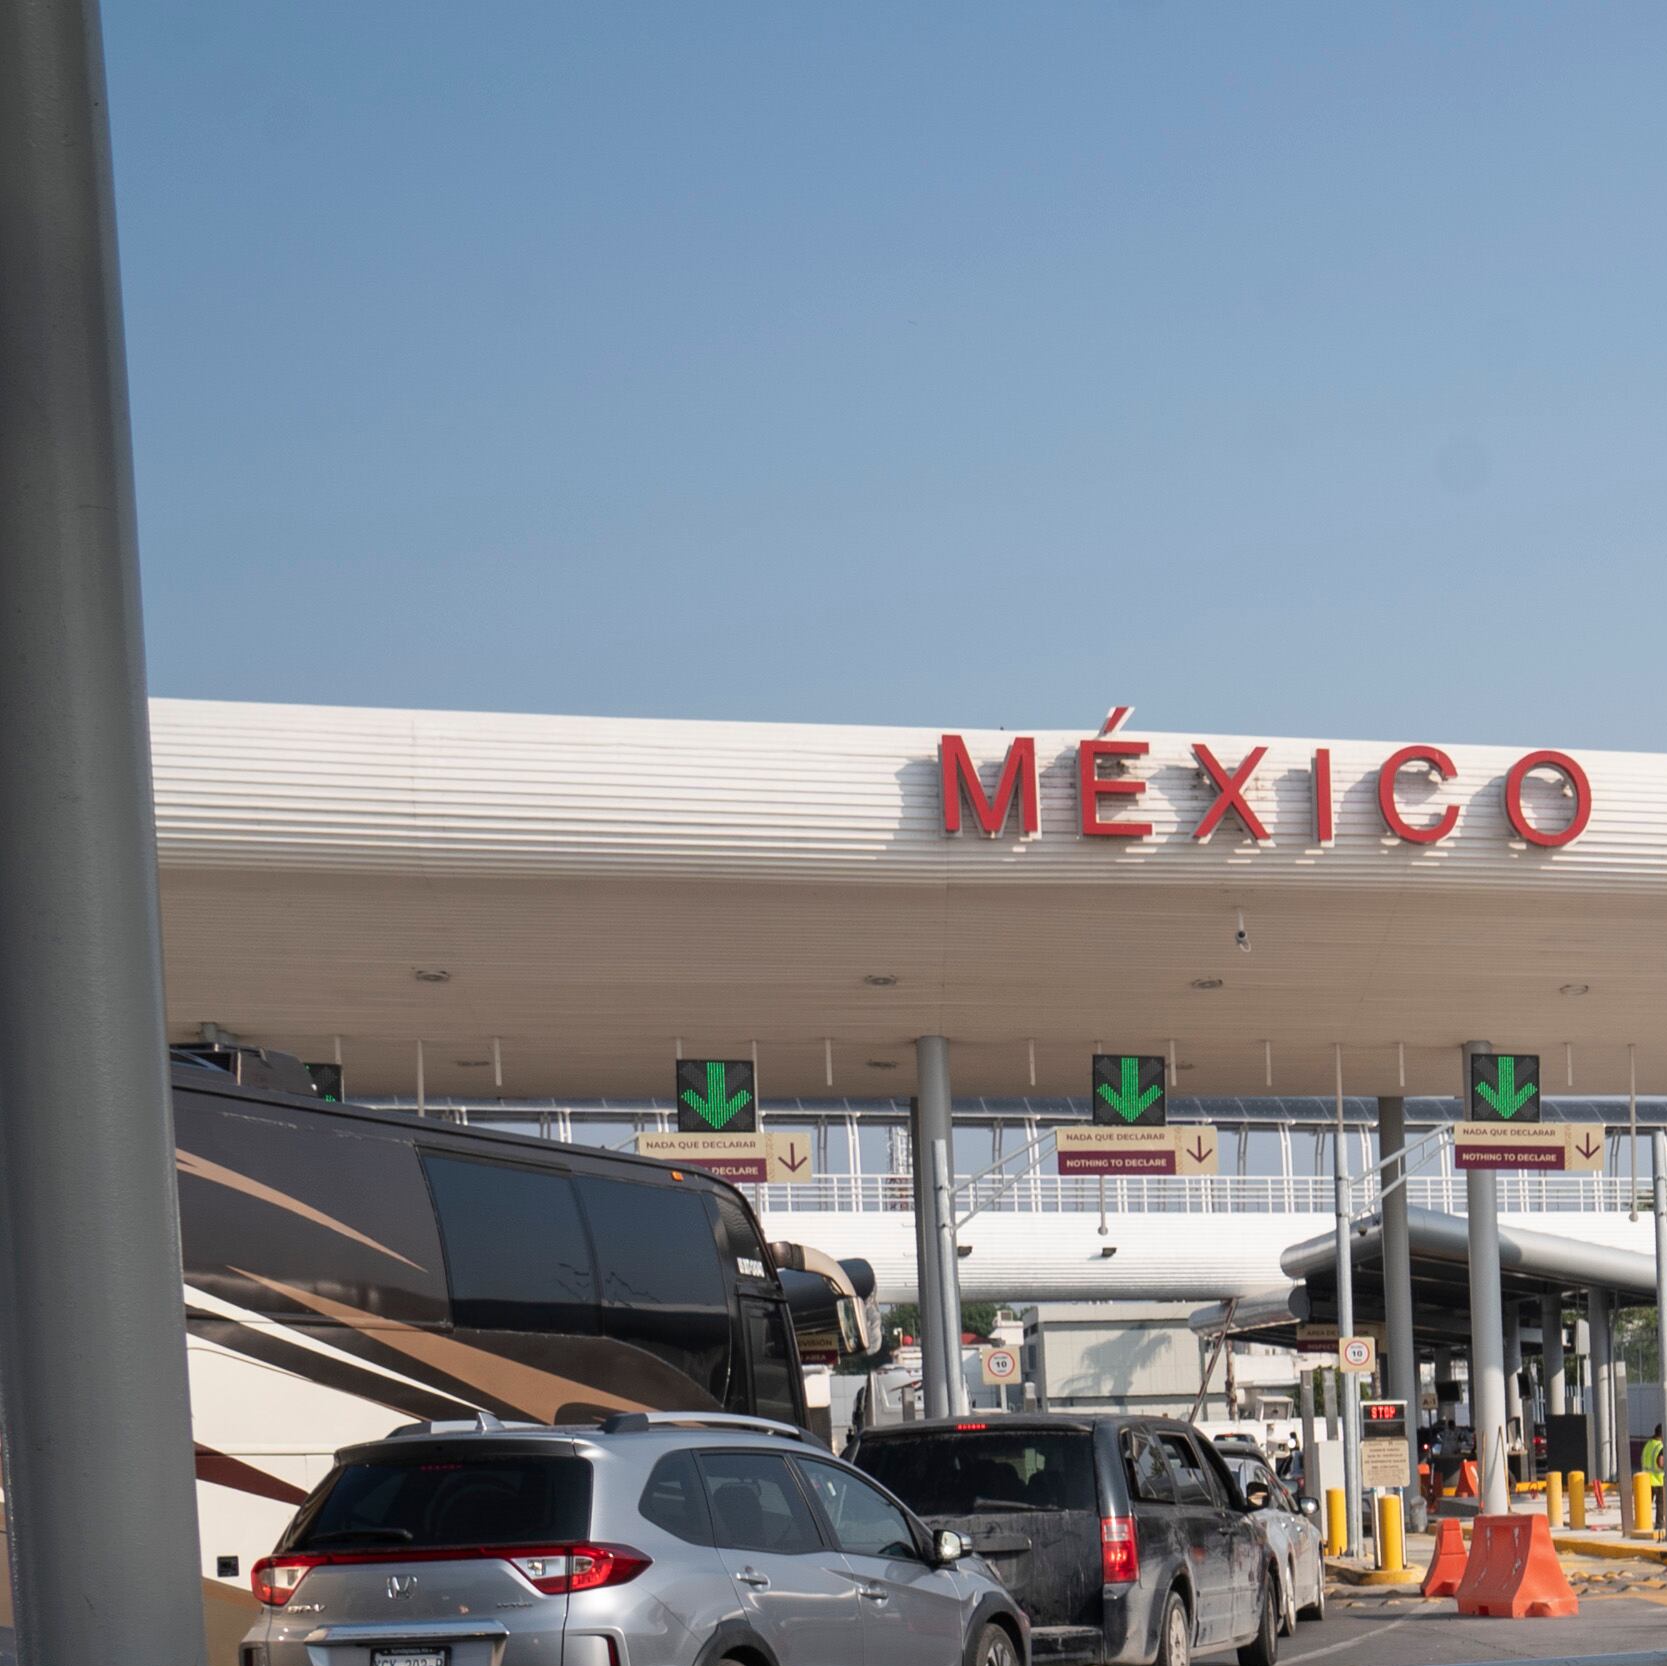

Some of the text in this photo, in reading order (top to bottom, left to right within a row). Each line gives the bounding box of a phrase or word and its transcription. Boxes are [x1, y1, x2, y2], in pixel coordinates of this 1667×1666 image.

[941, 706, 1593, 848] MÉXICO
[1066, 1132, 1165, 1142] NADA QUE DECLARAR
[1463, 1128, 1556, 1137] NADA QUE DECLARAR
[646, 1140, 756, 1150] NADA QUE DECLARAR
[1462, 1152, 1557, 1162] NOTHING TO DECLARE
[1066, 1158, 1167, 1168] NOTHING TO DECLARE
[711, 1166, 759, 1176] DECLARE
[1352, 1349, 1363, 1358] 10
[996, 1360, 1007, 1369] 10
[1371, 1405, 1397, 1420] STOP
